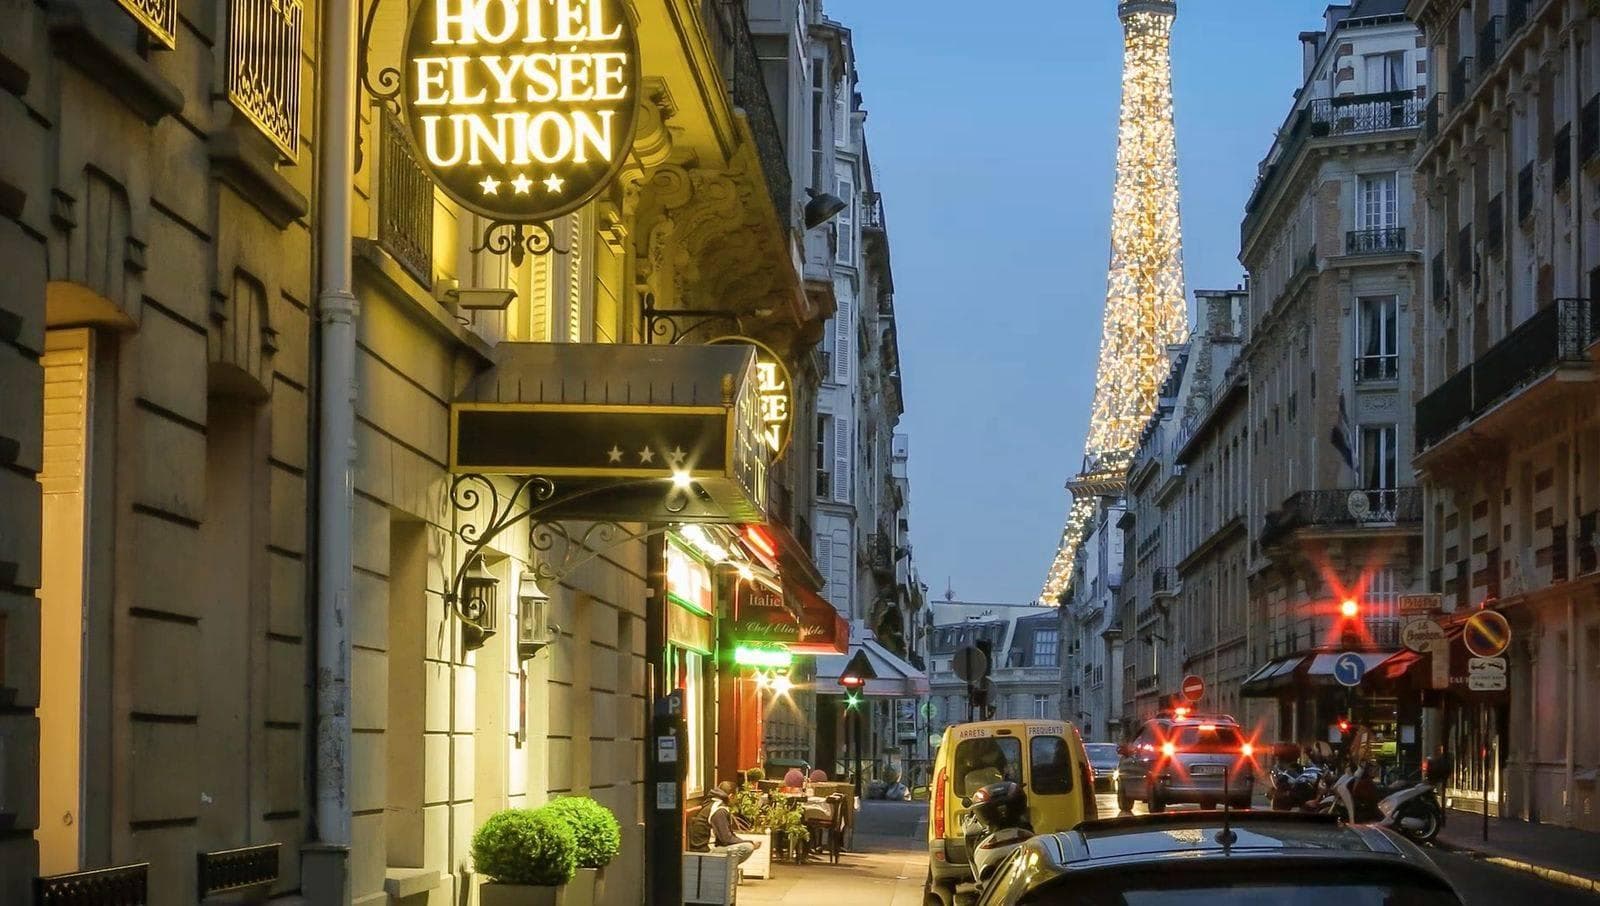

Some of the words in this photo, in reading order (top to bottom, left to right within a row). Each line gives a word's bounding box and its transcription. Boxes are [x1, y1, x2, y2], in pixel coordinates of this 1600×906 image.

[413, 45, 628, 106] ELYSÉE
[421, 110, 615, 167] UNION
[668, 696, 681, 714] P
[959, 729, 985, 739] ARRETS
[1028, 726, 1064, 736] FREQUENTS
